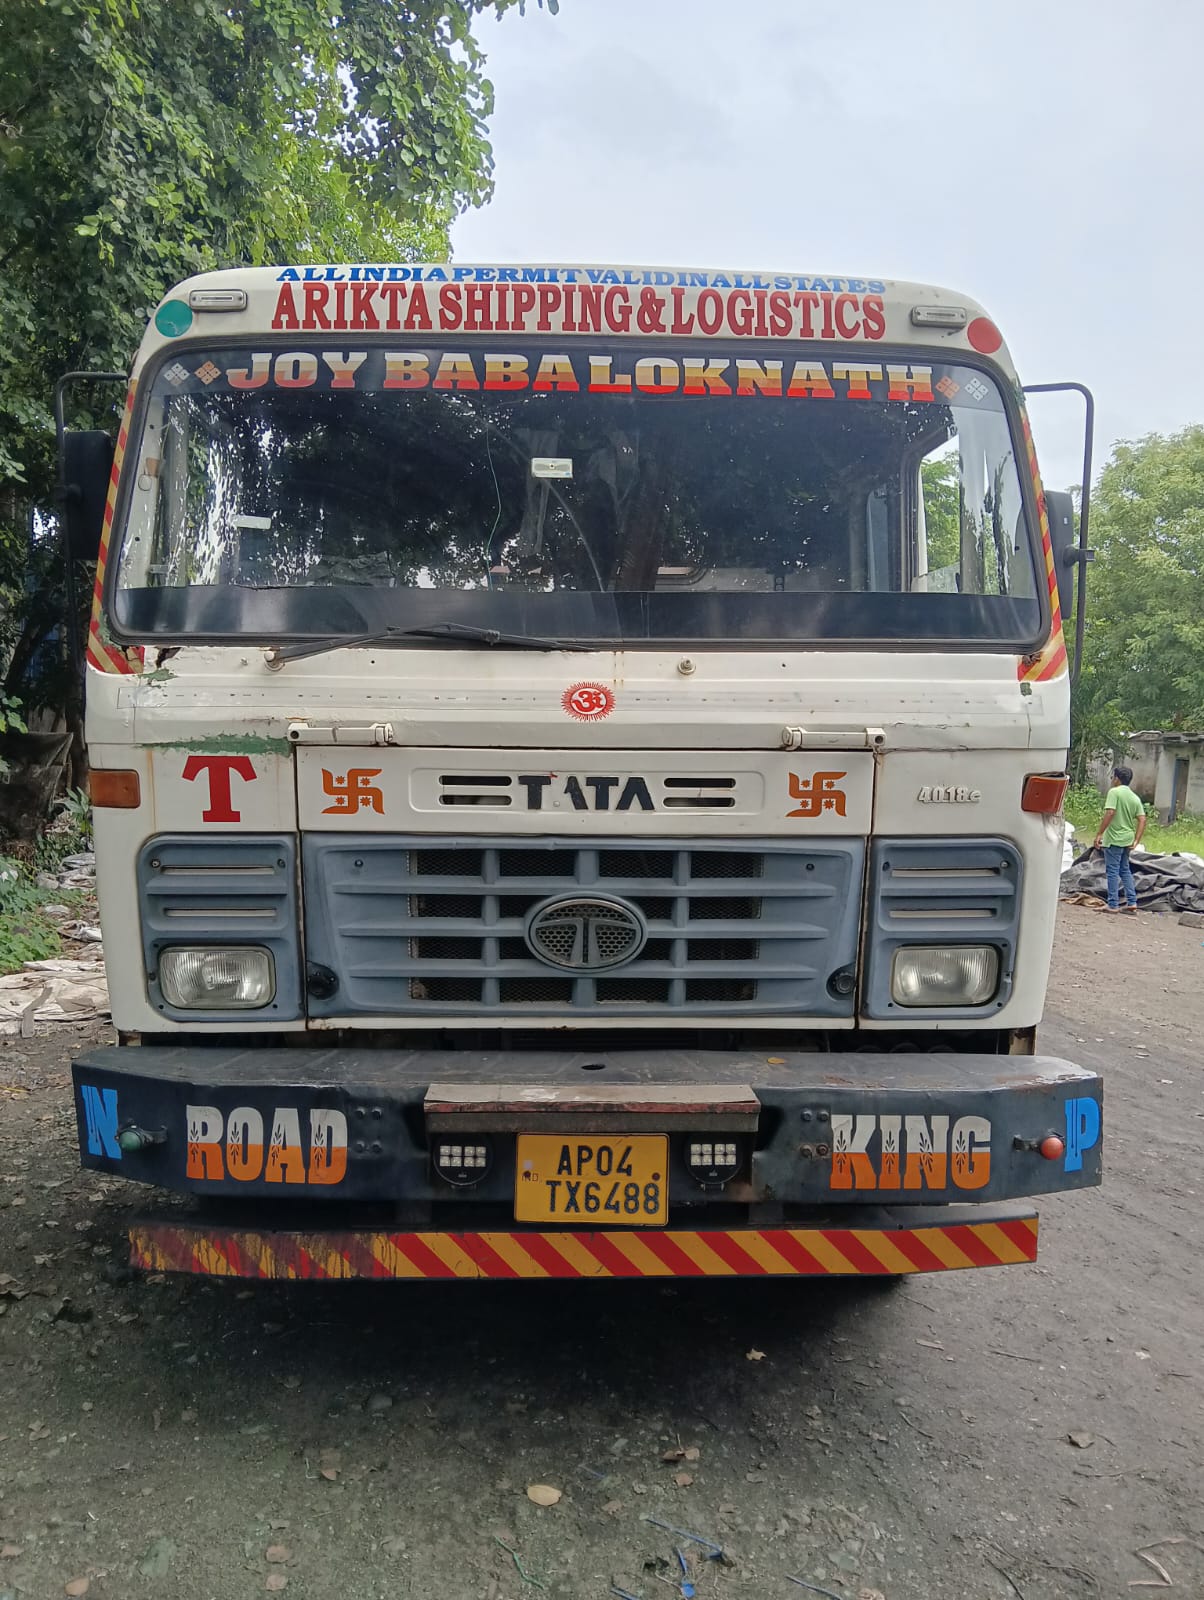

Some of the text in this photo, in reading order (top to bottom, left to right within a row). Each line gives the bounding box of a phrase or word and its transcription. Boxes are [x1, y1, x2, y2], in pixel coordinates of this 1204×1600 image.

[276, 267, 345, 282] ALL
[351, 267, 448, 282] INDIA
[453, 267, 583, 283] PERMIT
[585, 268, 675, 286] VALID
[774, 275, 886, 294] STATES
[272, 282, 432, 330] ARIKTA
[439, 283, 632, 333] SHIPPING
[671, 287, 886, 341] LOGISTICS
[226, 351, 935, 402] JOY BABA LOKNATH
[182, 755, 258, 823] T
[518, 775, 655, 810] TATA
[81, 1085, 122, 1160] N
[186, 1104, 348, 1185] ROAD
[830, 1114, 992, 1190] KING
[1064, 1096, 1100, 1173] P
[556, 1144, 633, 1177] AP04
[545, 1180, 661, 1215] TX6488
